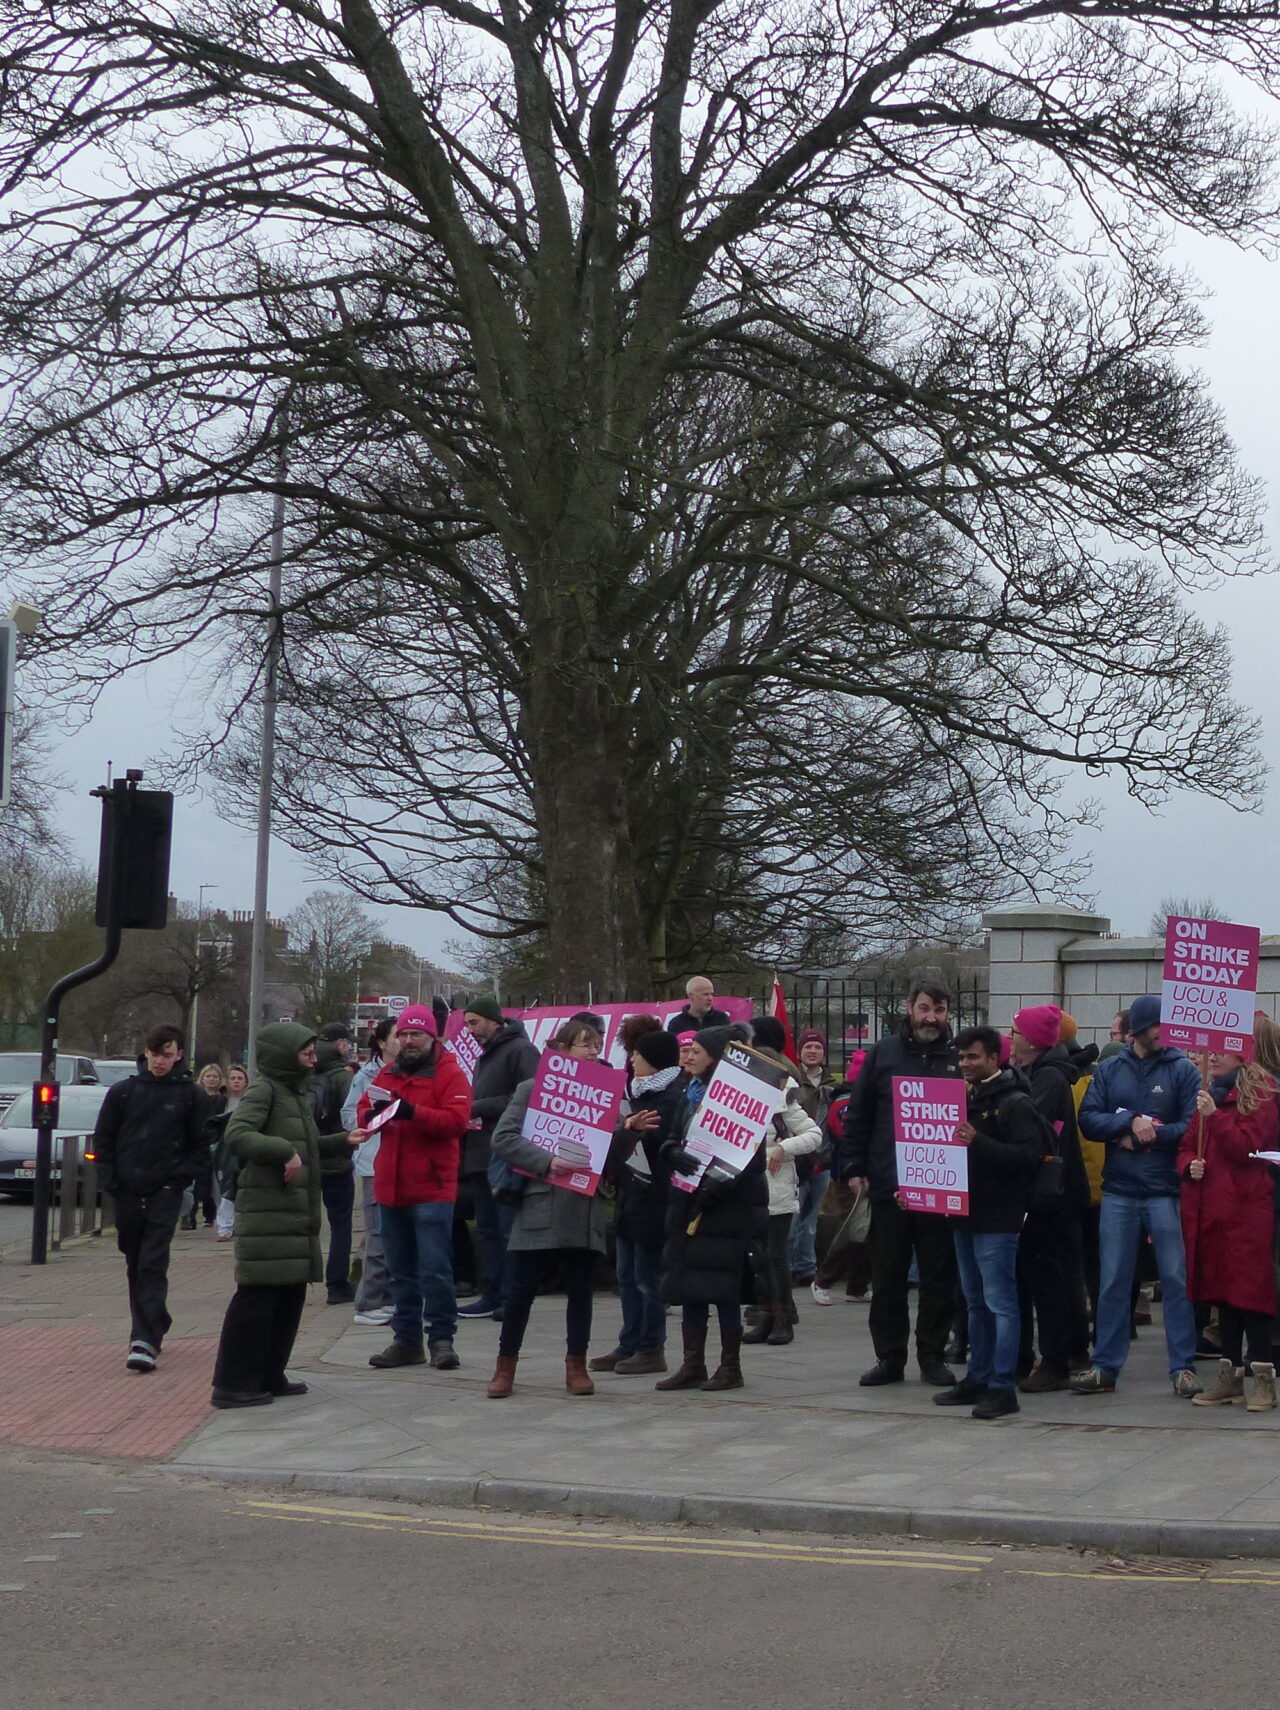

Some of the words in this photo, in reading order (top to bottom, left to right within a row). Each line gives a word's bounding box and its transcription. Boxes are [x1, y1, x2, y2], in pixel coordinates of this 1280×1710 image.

[1175, 921, 1207, 940] ON
[1173, 941, 1250, 967] STRIKE
[1173, 961, 1244, 985] TODAY
[1173, 985, 1215, 1005] UCU
[1216, 991, 1228, 1007] &
[1171, 1005, 1240, 1028] PROUD
[454, 1035, 477, 1071] TODA
[460, 1026, 484, 1058] STRI
[548, 1055, 579, 1077] ON
[542, 1073, 614, 1108] STRIKE
[900, 1081, 924, 1099] ON
[539, 1092, 605, 1125] TODAY
[708, 1079, 770, 1126] OFFICIAL
[900, 1101, 960, 1121] STRIKE
[574, 1128, 585, 1142] &
[700, 1108, 756, 1150] PICKET
[901, 1122, 956, 1142] TODAY
[904, 1146, 936, 1164] UCU
[937, 1148, 946, 1165] &
[905, 1166, 957, 1187] PROUD
